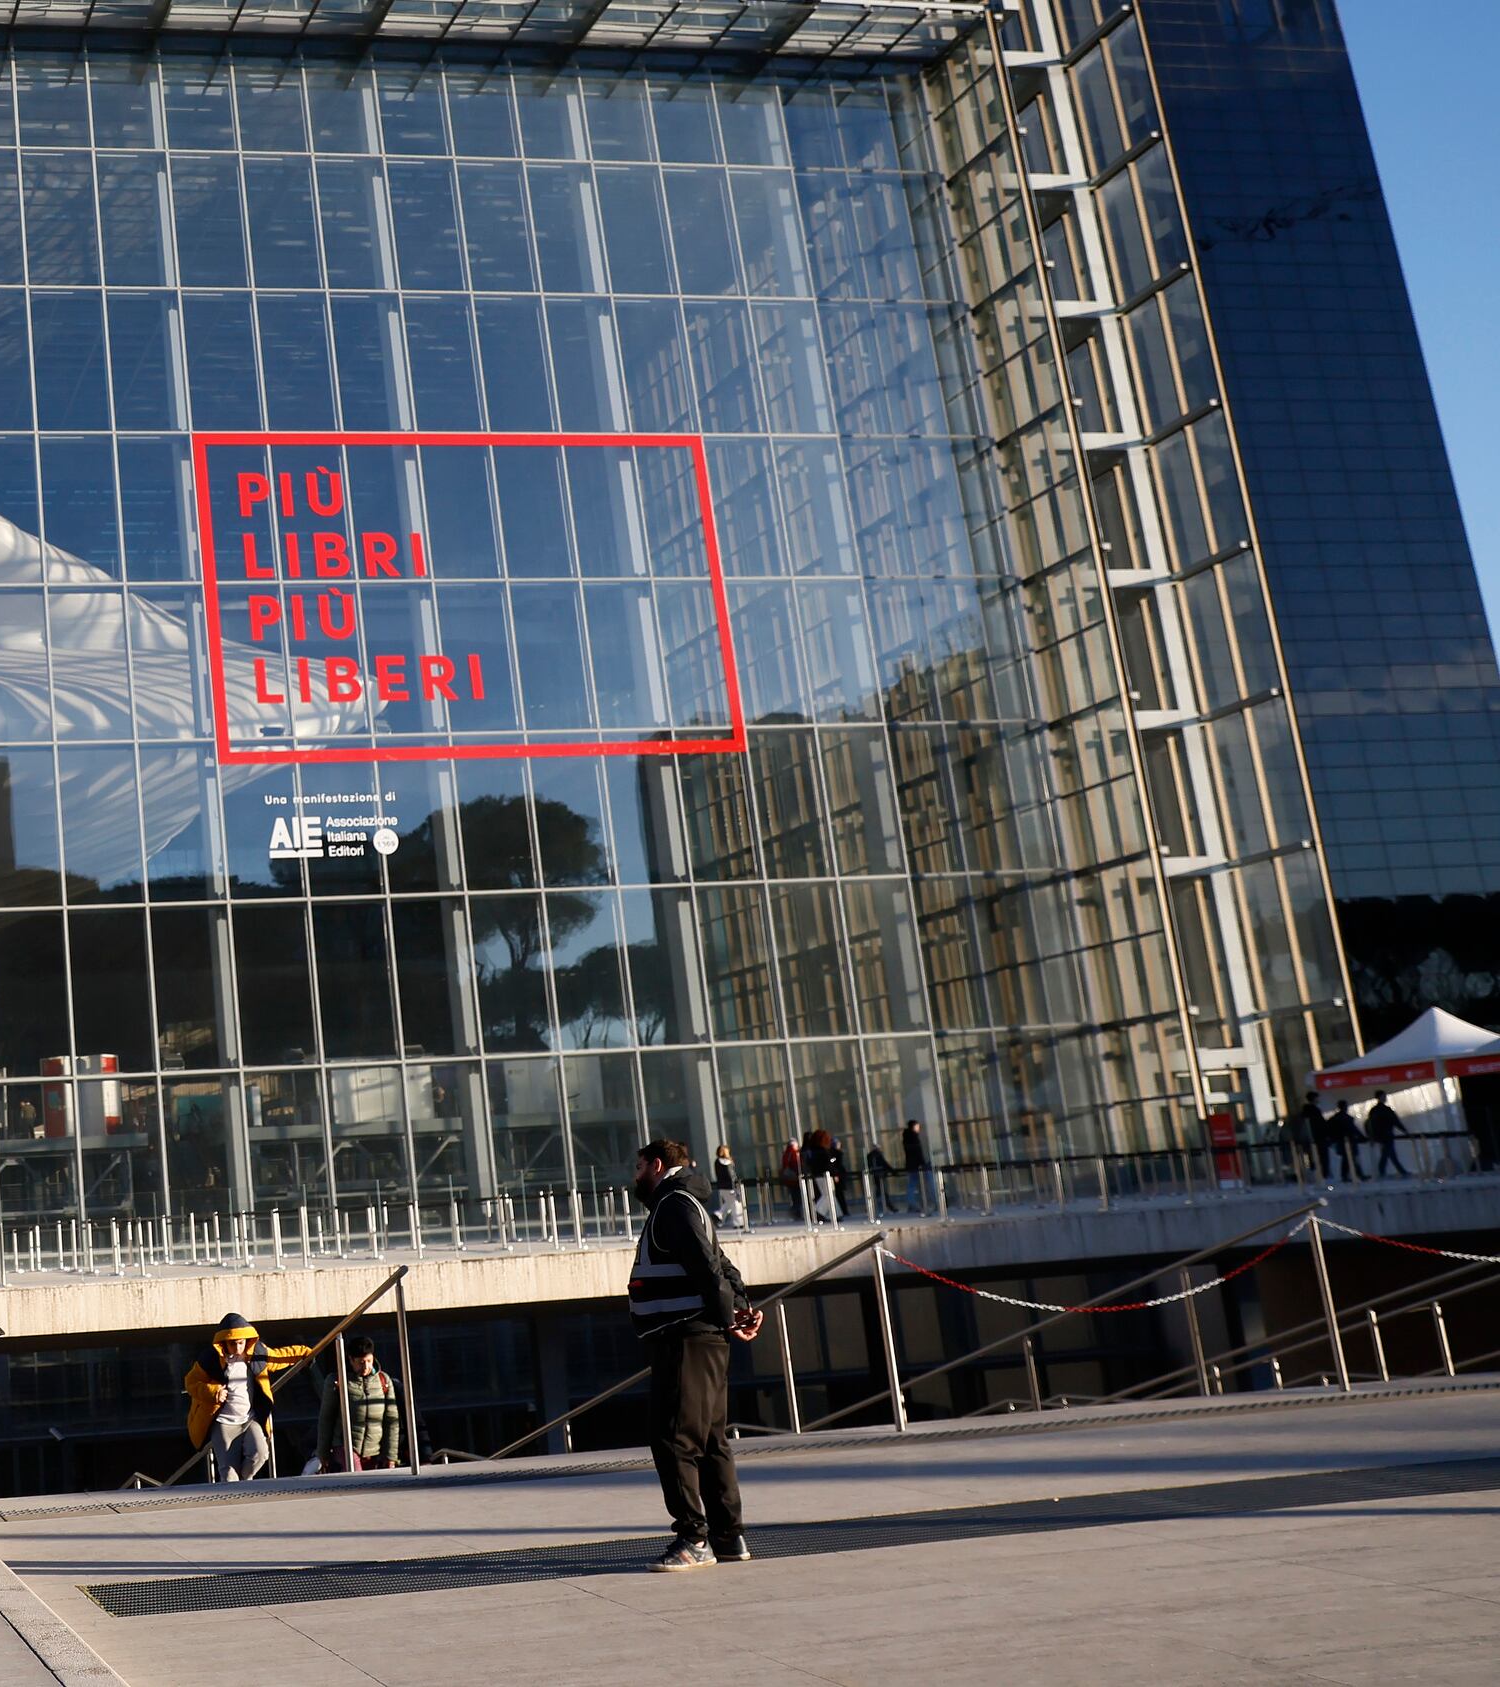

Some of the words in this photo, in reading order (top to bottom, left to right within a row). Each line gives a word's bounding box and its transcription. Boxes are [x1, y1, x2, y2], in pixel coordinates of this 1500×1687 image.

[237, 466, 344, 517] PIÙ
[243, 532, 426, 579] LIBRI
[248, 587, 356, 641] PIÙ
[253, 654, 485, 704] LIBERI
[264, 795, 287, 805] Una
[293, 793, 380, 804] manifestazione
[384, 791, 396, 802] di
[269, 816, 323, 849] AIE
[325, 816, 398, 828] Associazione
[327, 831, 367, 842] Italiana
[328, 845, 365, 857] Editori
